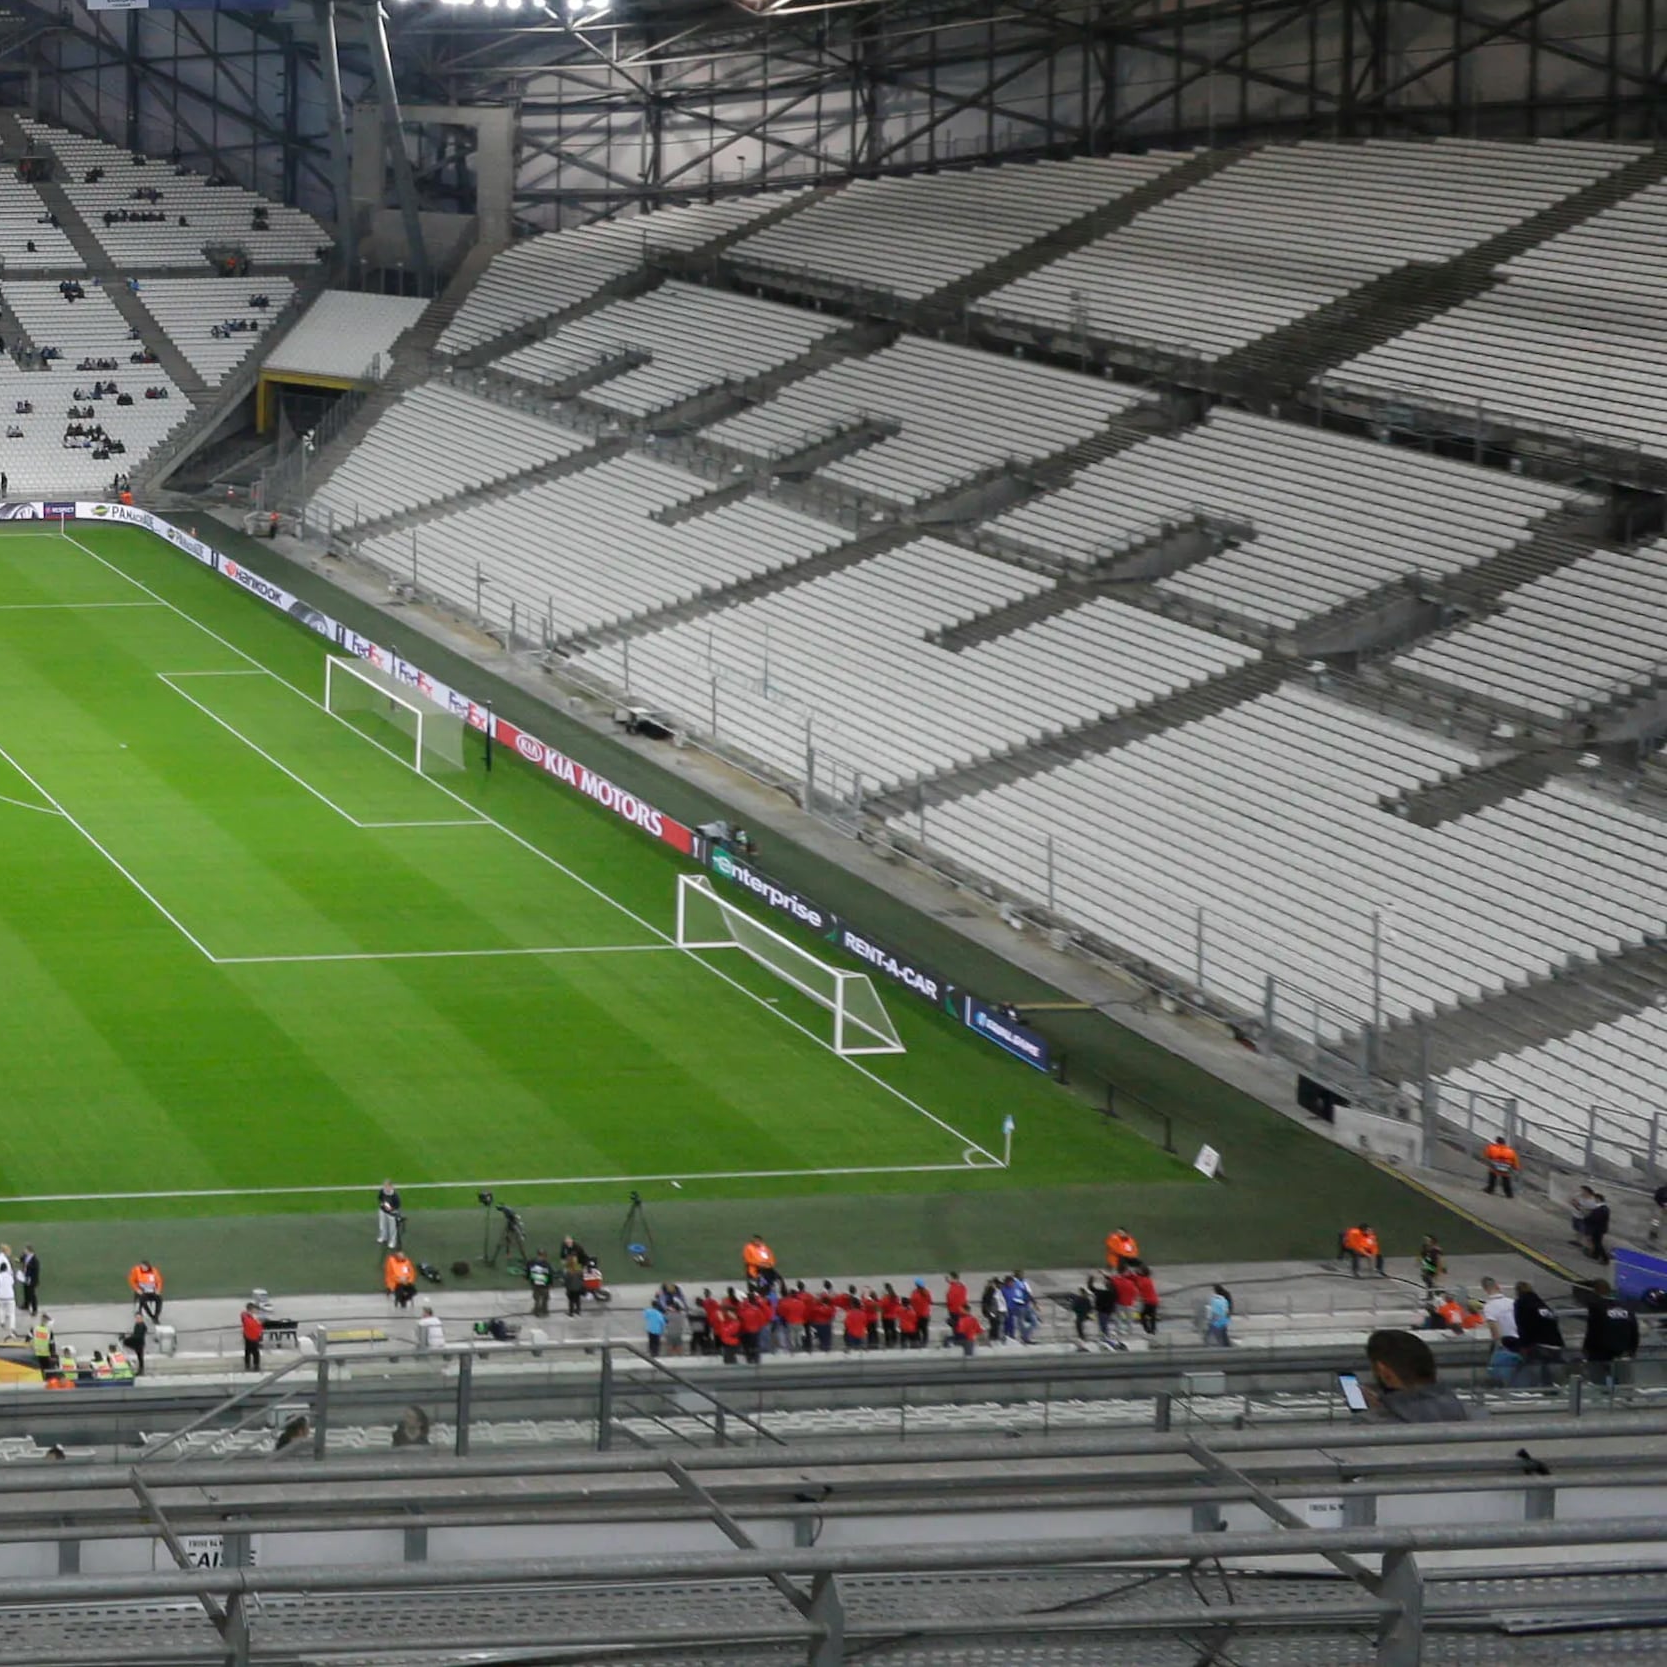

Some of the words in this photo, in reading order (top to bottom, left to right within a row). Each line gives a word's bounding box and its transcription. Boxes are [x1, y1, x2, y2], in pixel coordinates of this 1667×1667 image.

[519, 739, 540, 759] KIA
[544, 748, 577, 788] KIA
[580, 770, 664, 837] MOTORS
[717, 857, 823, 929] enterprise
[845, 932, 938, 1001] RENT-A-CAR
